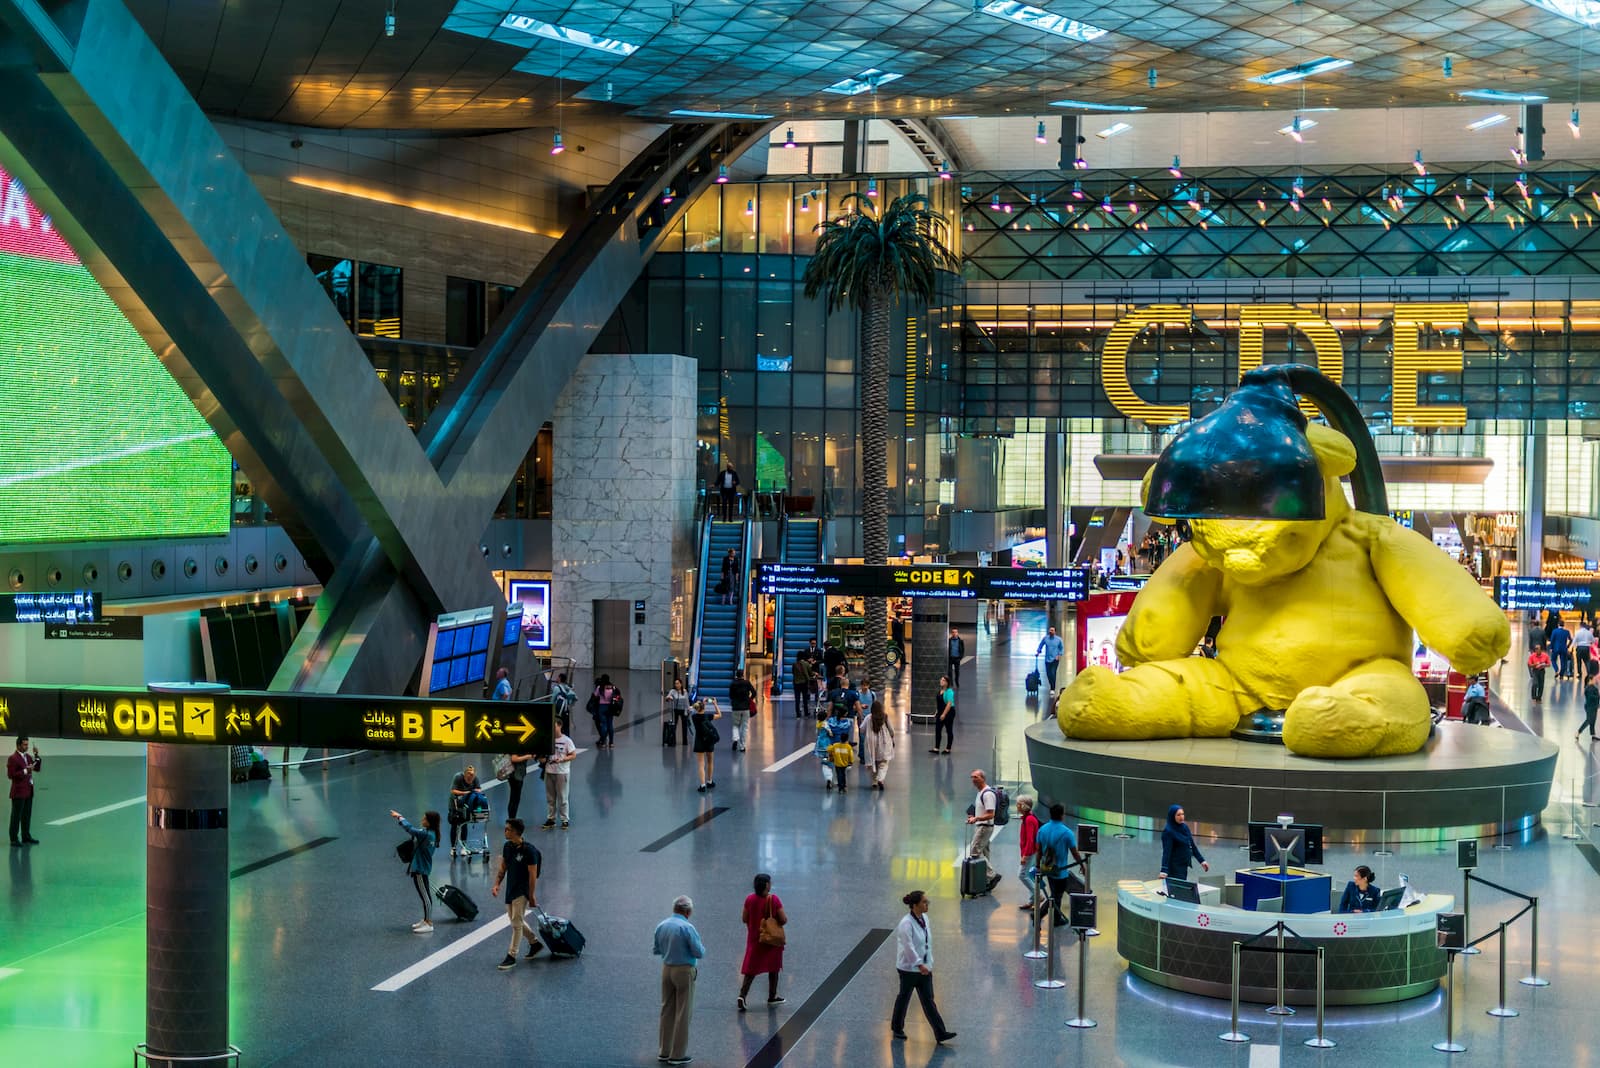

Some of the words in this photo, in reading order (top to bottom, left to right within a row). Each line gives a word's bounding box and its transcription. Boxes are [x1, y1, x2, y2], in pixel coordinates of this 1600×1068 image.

[910, 570, 942, 583] CDE
[16, 612, 40, 621] Lounges
[77, 700, 107, 715] بوابات
[113, 701, 176, 733] CDE
[240, 712, 250, 720] 10
[364, 711, 395, 726] بوابات
[80, 718, 106, 729] Gates
[402, 712, 424, 739] B
[494, 720, 500, 728] 3
[366, 728, 395, 739] Gates
